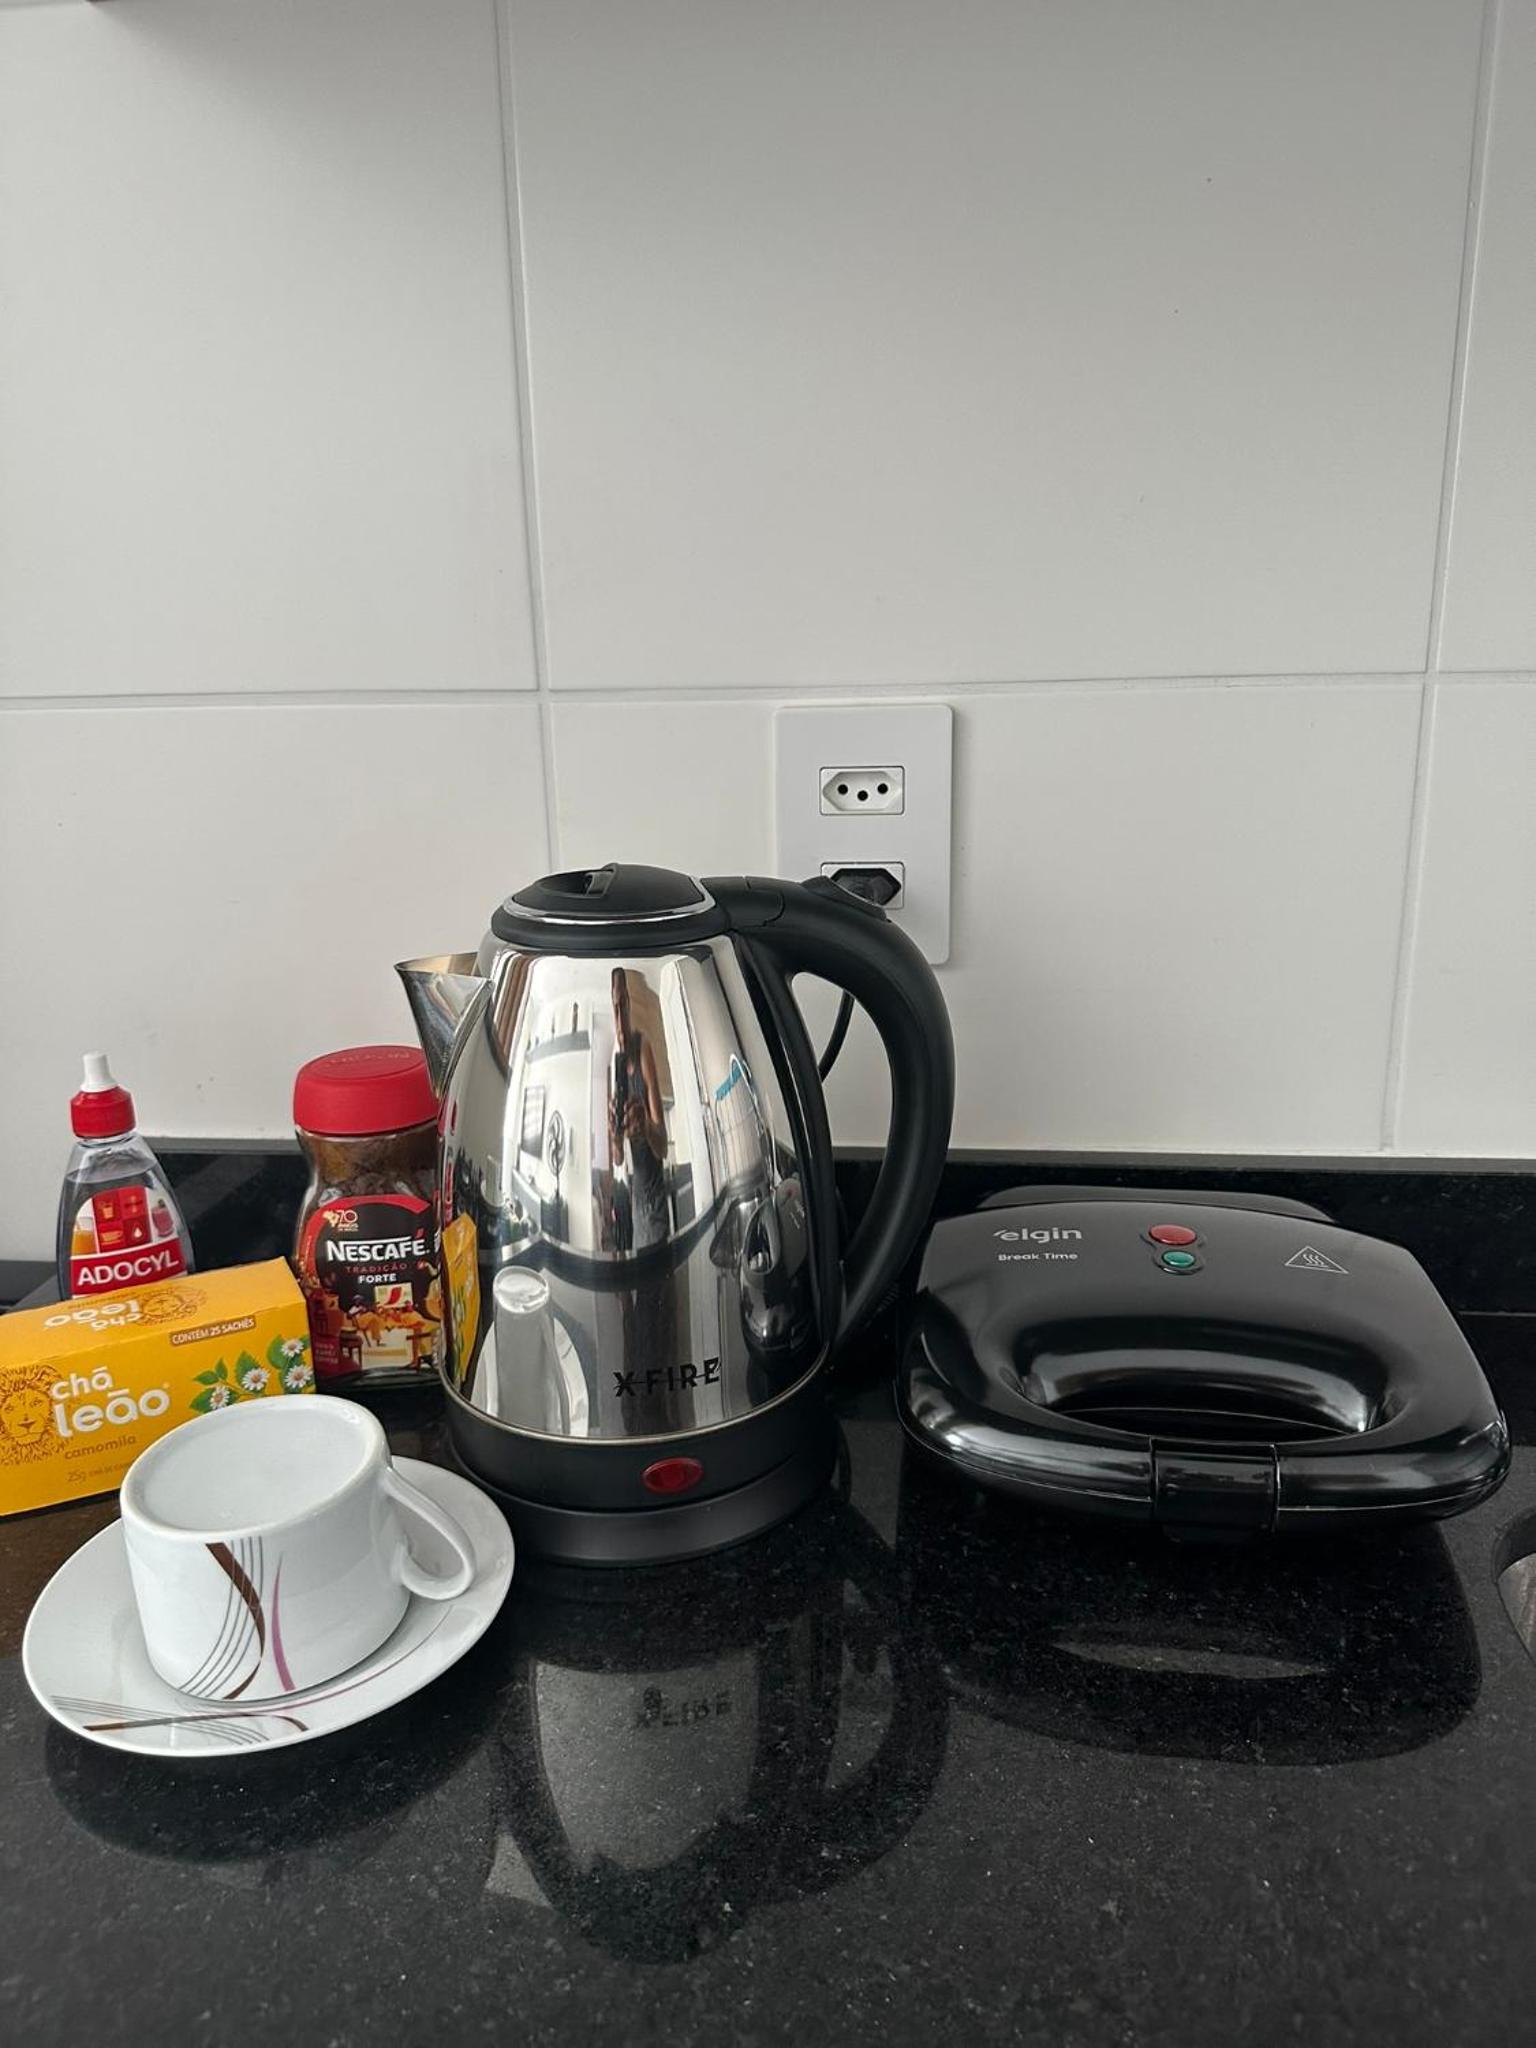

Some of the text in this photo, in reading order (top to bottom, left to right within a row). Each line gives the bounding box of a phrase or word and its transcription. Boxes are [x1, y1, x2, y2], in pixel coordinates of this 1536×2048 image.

[336, 1209, 358, 1223] 70
[993, 1227, 1082, 1243] elgin
[326, 1229, 426, 1262] NESCAFÉ
[998, 1252, 1078, 1261] Break Time
[77, 1248, 179, 1286] ADOCYL
[358, 1273, 397, 1284] FORTE
[210, 1326, 221, 1337] 25
[65, 1435, 136, 1459] camomila
